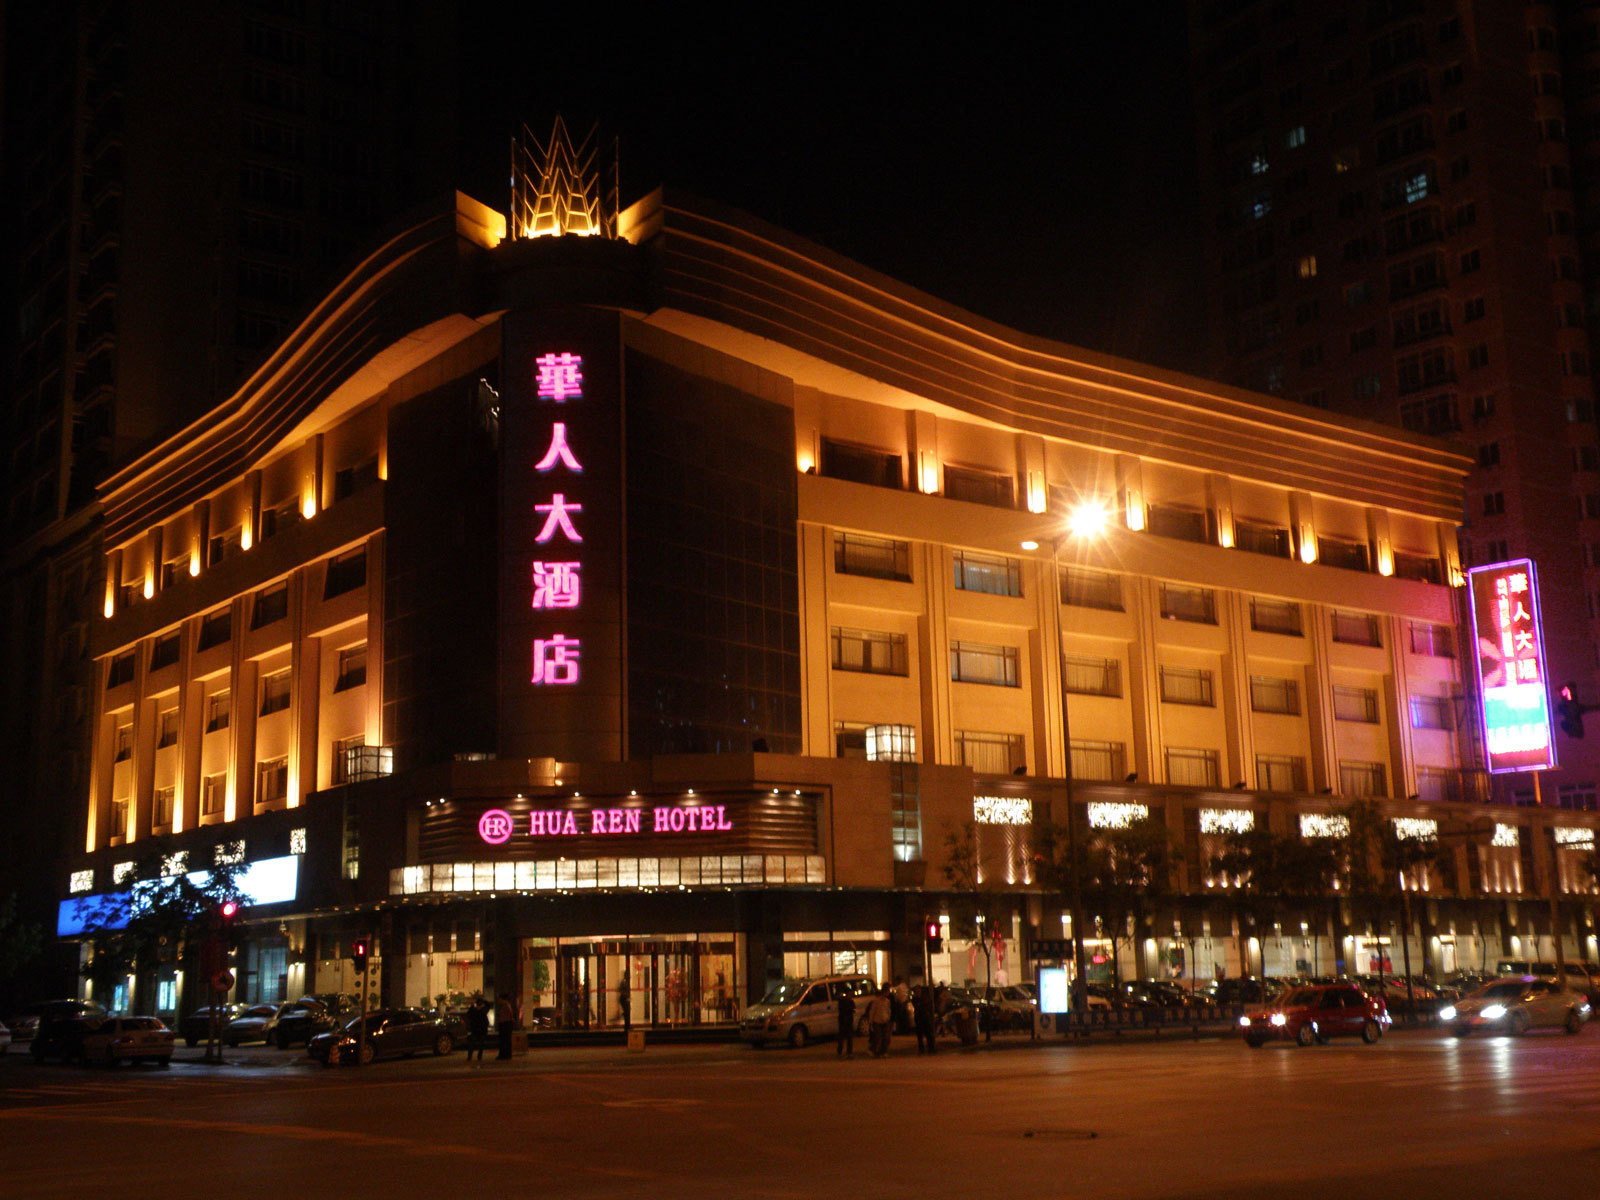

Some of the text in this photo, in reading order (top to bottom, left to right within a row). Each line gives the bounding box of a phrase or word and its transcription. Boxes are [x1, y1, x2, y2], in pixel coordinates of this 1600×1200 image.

[532, 353, 583, 684] 華人大酒店
[530, 806, 732, 835] HUA REN HOTEL
